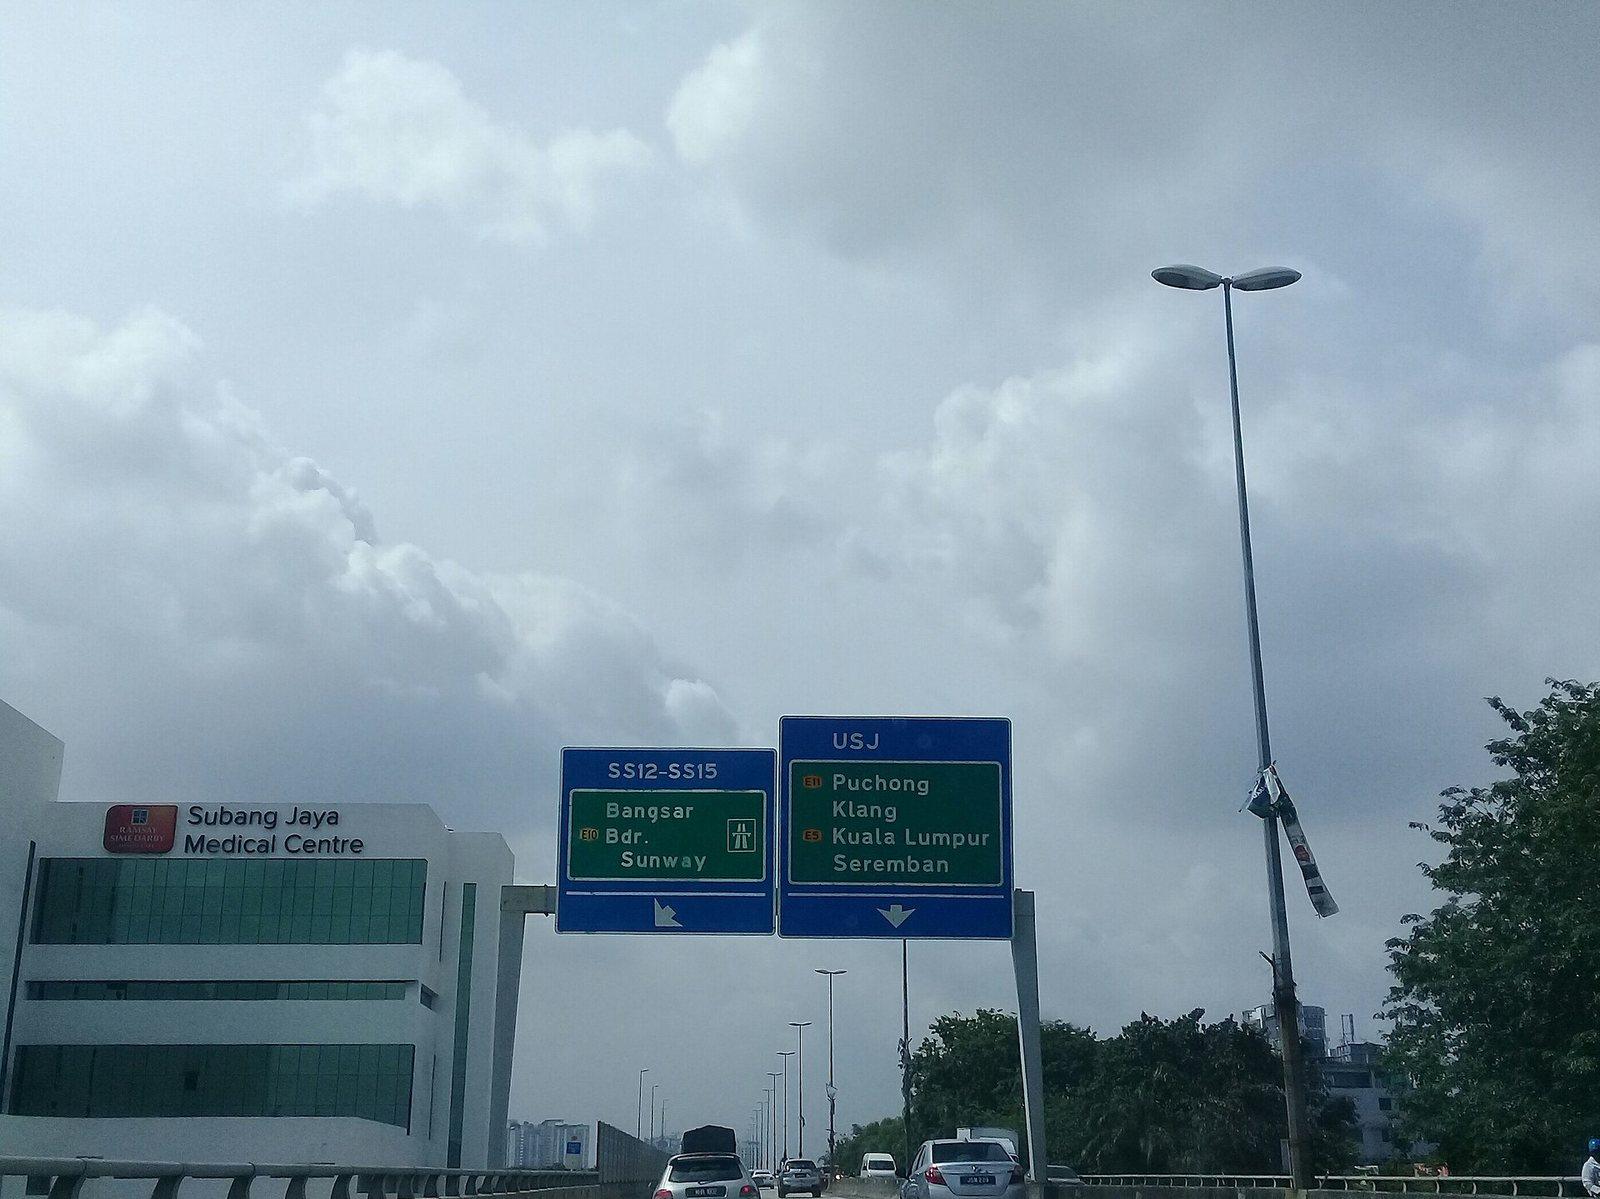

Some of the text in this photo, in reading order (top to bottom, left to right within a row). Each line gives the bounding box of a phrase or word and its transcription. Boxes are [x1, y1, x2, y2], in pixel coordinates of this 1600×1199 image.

[833, 732, 880, 749] USJ
[608, 763, 718, 779] SS12-SS15
[804, 777, 821, 786] E11
[832, 773, 930, 796] Puchong
[187, 806, 339, 829] Subang Jaya
[606, 803, 694, 823] Bangsar
[832, 801, 898, 823] Klang
[184, 834, 364, 854] Medical Centre
[581, 829, 597, 840] E10
[606, 828, 649, 844] Bdr.
[804, 830, 820, 840] E5
[832, 828, 990, 849] Kuala Lumpur
[620, 851, 706, 871] Sunway
[833, 854, 949, 873] Seremban
